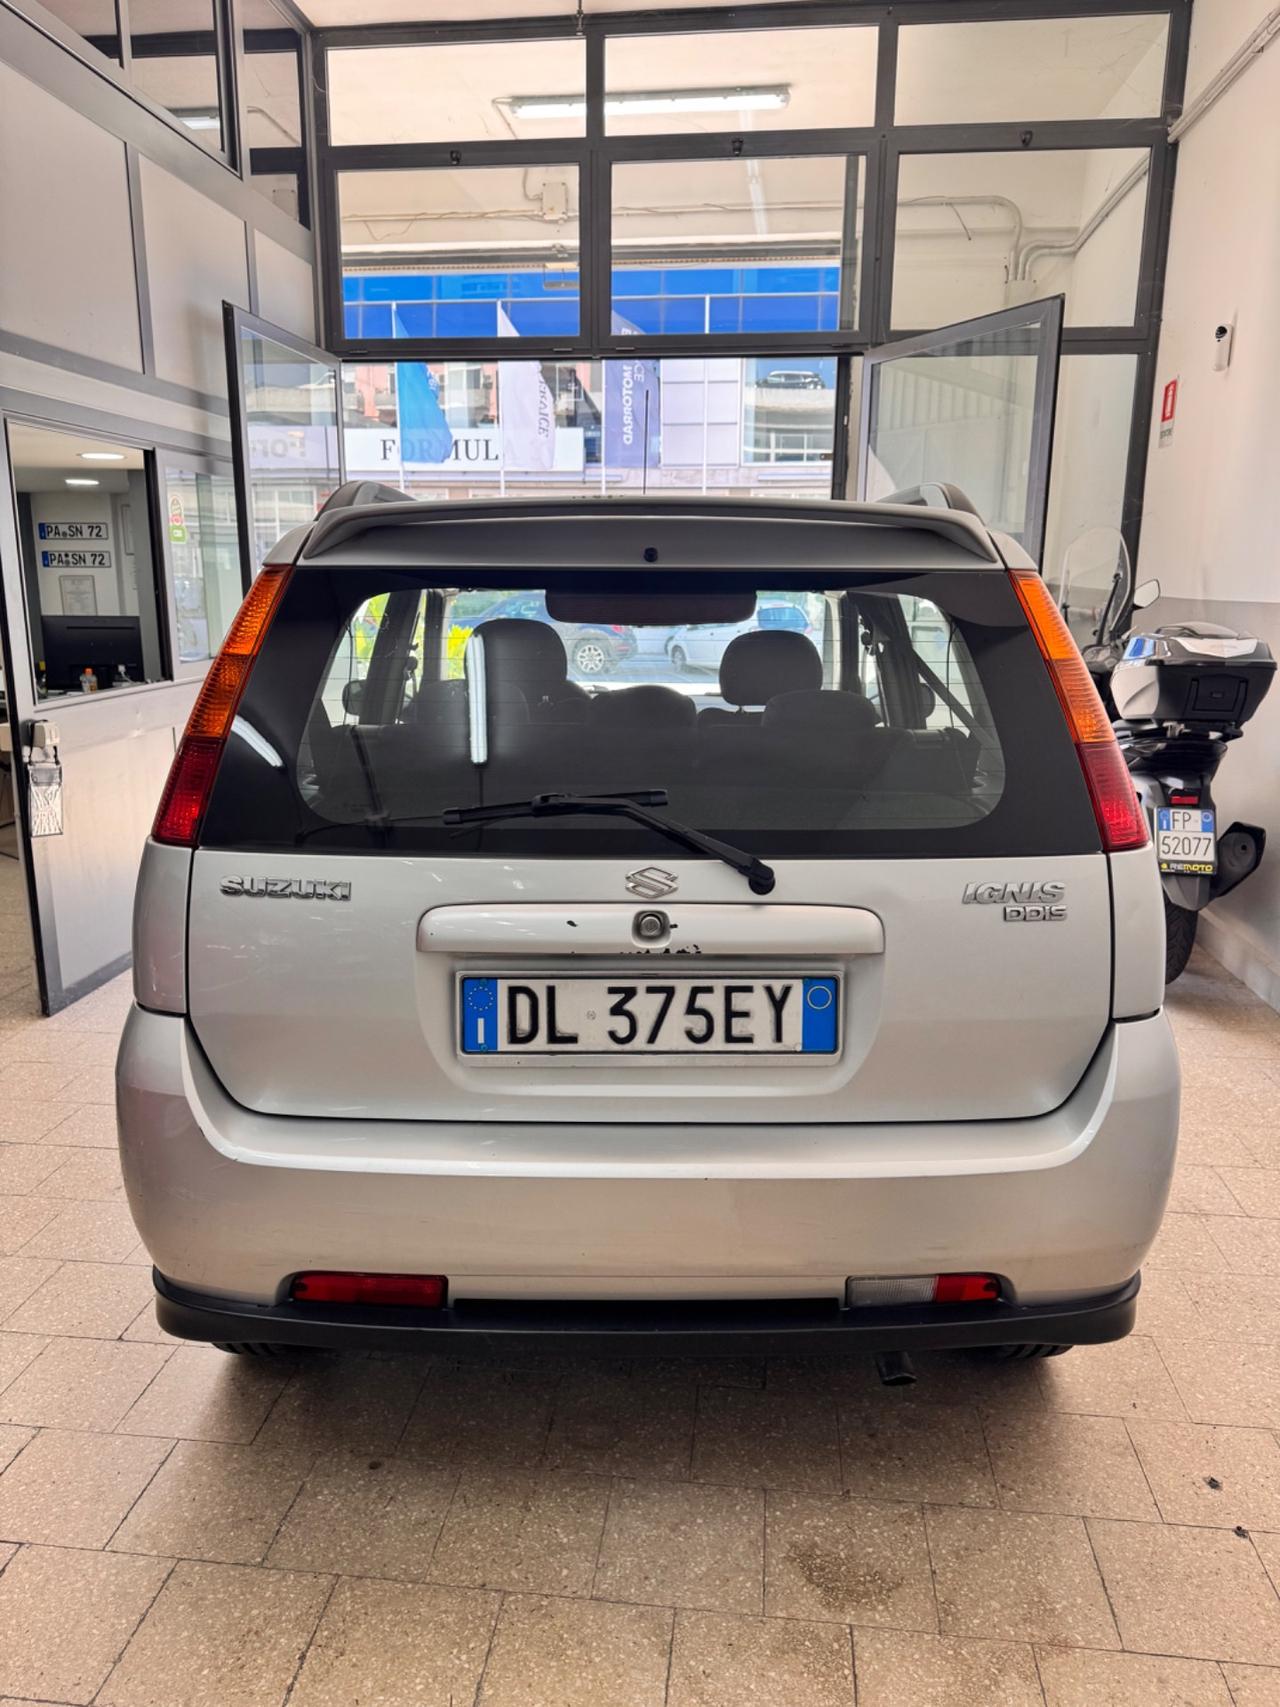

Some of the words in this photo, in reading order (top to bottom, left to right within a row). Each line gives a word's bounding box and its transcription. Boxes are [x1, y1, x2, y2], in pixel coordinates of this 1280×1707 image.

[46, 526, 60, 537] PA
[68, 525, 83, 537] SN
[88, 525, 102, 538] 72
[49, 553, 64, 565] PA
[71, 553, 86, 565] SN
[91, 553, 105, 565] 72
[1172, 811, 1192, 829] FP
[1161, 836, 1212, 856] 52077
[219, 875, 352, 901] SUZUKI
[961, 881, 1066, 905] IGNIS
[507, 984, 579, 1045] DL
[606, 984, 793, 1045] 375EY
